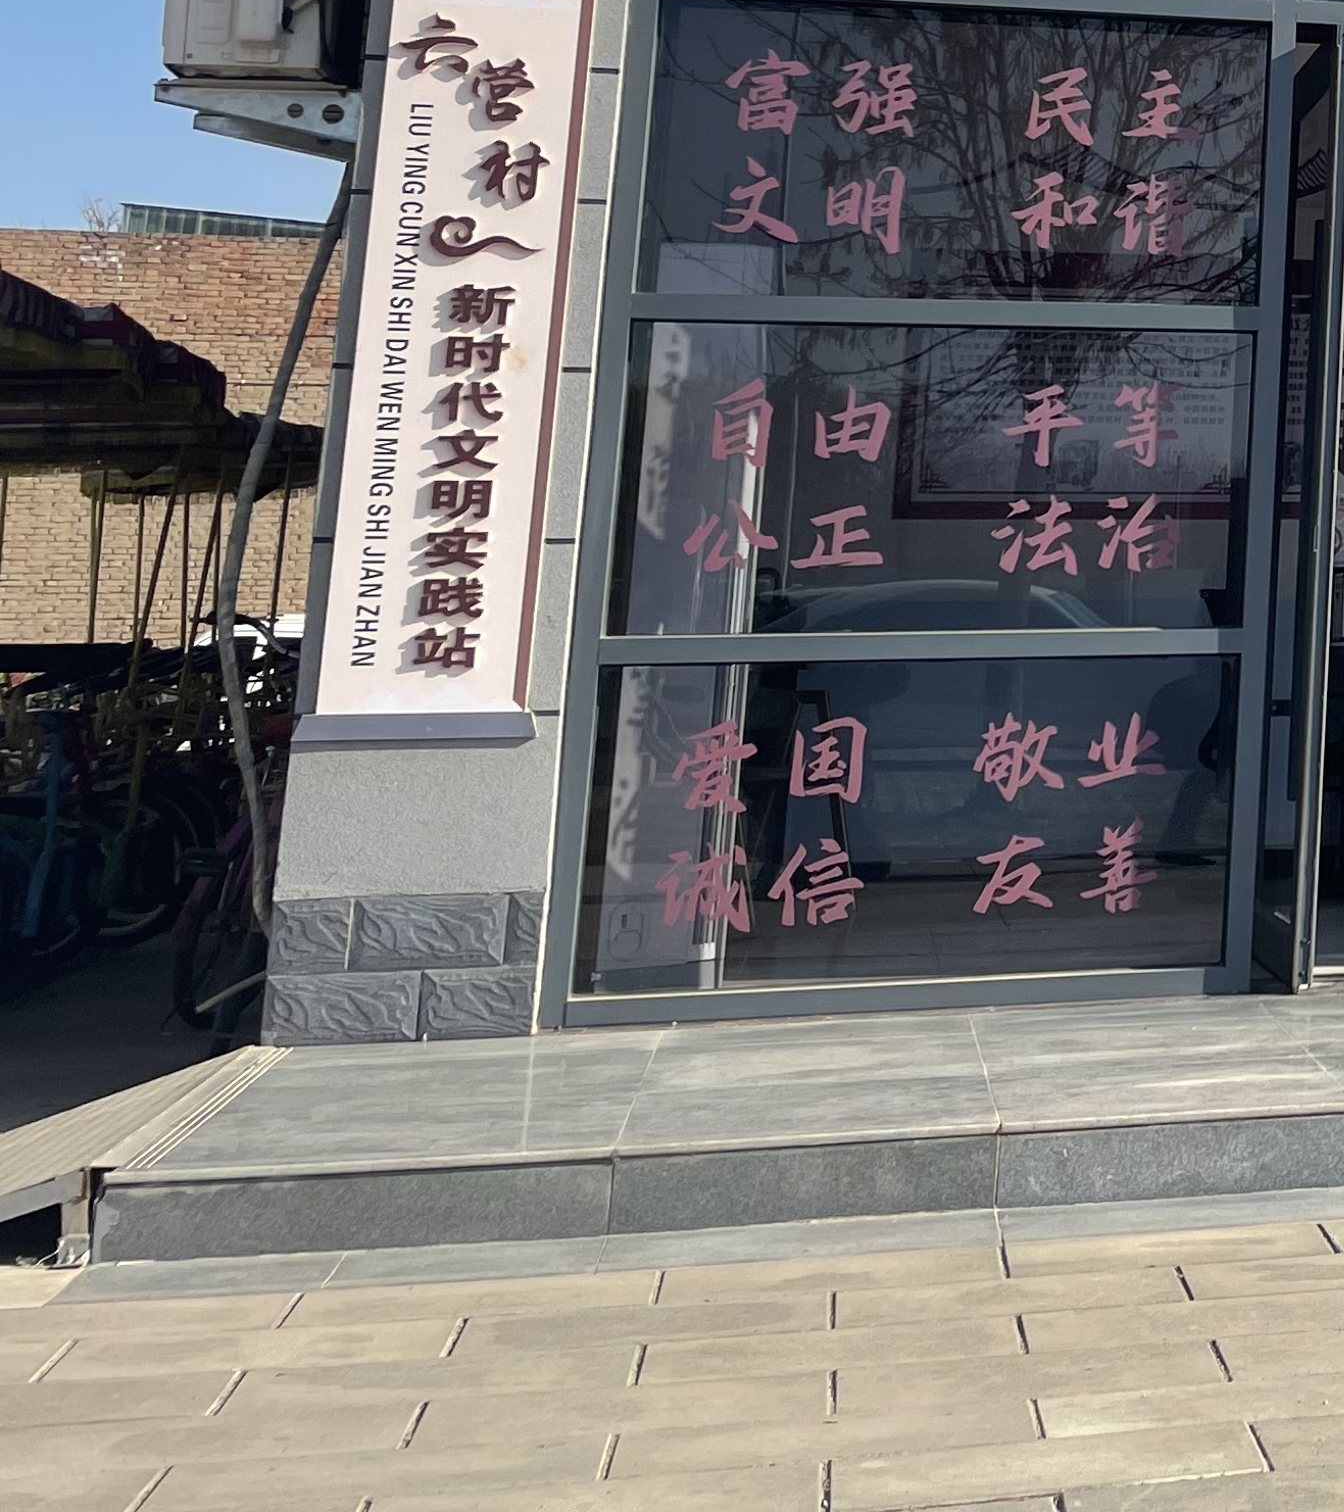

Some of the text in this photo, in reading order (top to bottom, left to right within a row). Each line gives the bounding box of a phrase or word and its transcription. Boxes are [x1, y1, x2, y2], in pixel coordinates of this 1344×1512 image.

[398, 12, 550, 202] 六营村
[724, 48, 1200, 147] 富强 民主
[711, 156, 1196, 257] 文明 和谐
[350, 103, 434, 667] LIU YING CUN XIN SHI DAI WEN MING SHI JIAN ZHAN
[710, 378, 892, 468] 自由
[1003, 382, 1178, 469] 平等
[412, 283, 517, 669] 新时代文明实践站
[683, 493, 1181, 576] 公正 法治
[671, 710, 1167, 813] 爱国 敬业
[656, 816, 1159, 933] 诚信 友善
